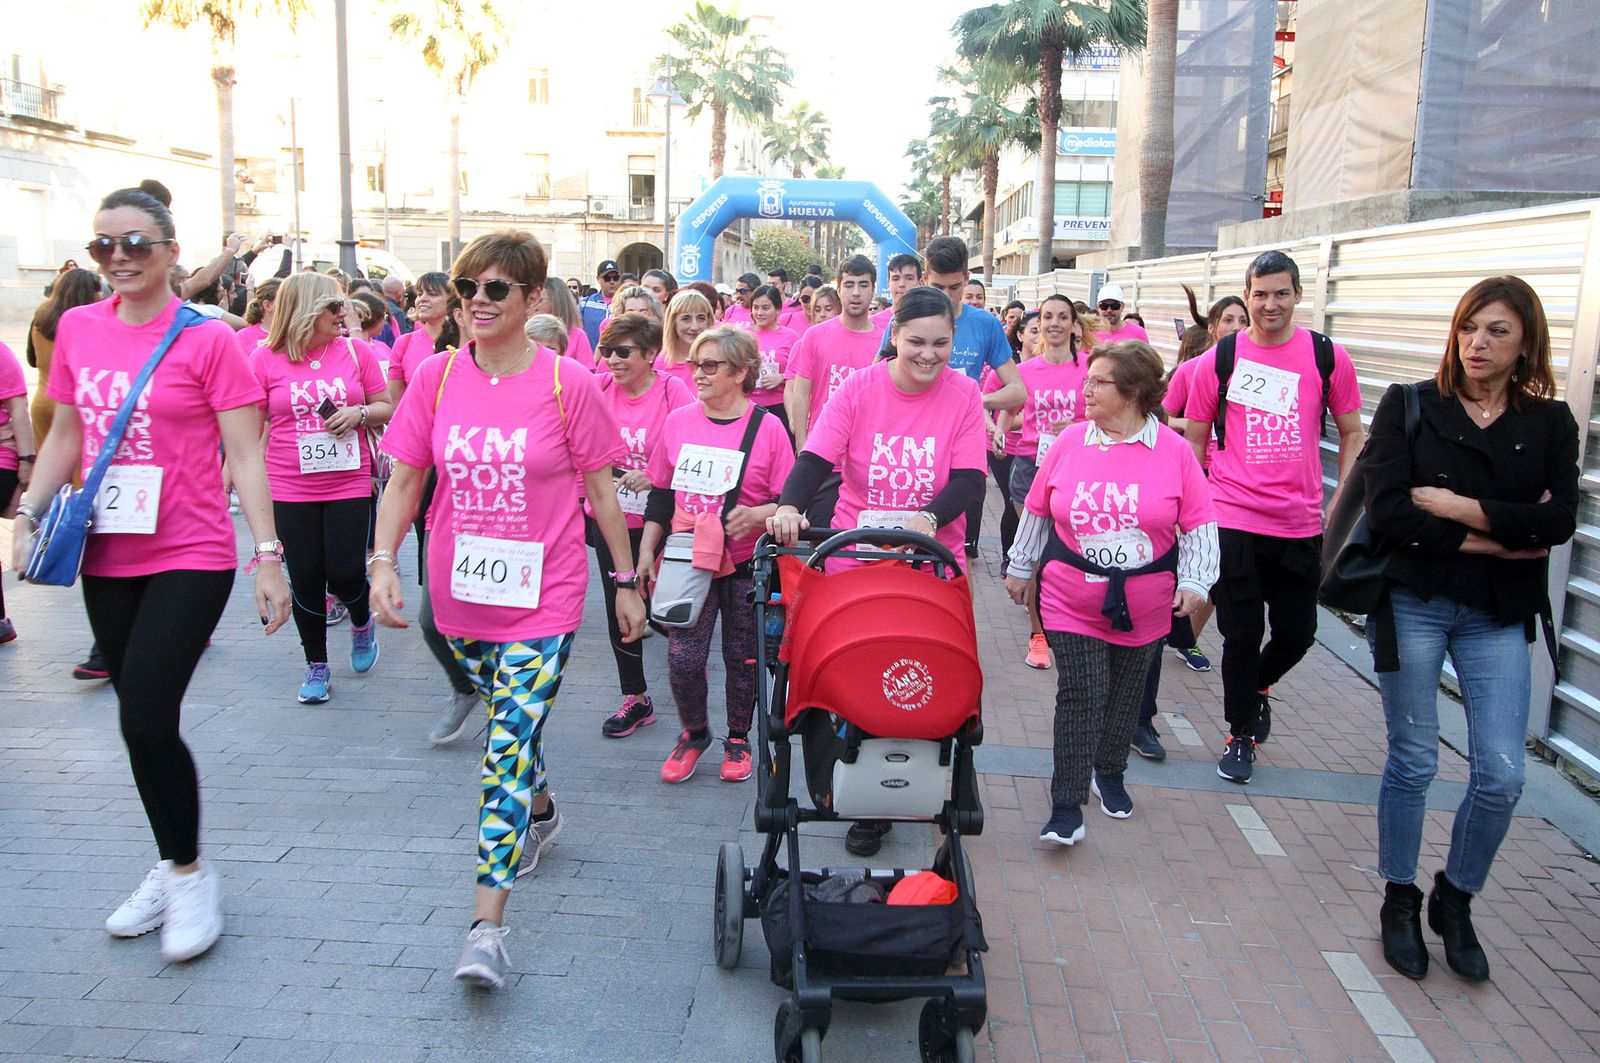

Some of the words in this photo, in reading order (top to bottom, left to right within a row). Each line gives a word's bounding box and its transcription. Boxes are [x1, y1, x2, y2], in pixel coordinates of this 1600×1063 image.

[691, 193, 728, 229] DEPORTES
[788, 207, 835, 217] HUELVA
[789, 199, 825, 207] Ayuntamiento
[863, 199, 898, 236] DEPORTES
[76, 367, 155, 410] KM
[290, 377, 347, 404] KM
[1240, 373, 1266, 394] 22
[1034, 389, 1076, 410] KM
[1246, 411, 1300, 432] POR
[444, 424, 528, 463] KM
[871, 432, 936, 468] KM
[1246, 430, 1302, 447] ELLAS
[301, 443, 338, 460] 354
[445, 462, 527, 491] POR
[678, 458, 714, 478] 441
[867, 464, 936, 491] POR
[452, 489, 527, 512] ELLAS
[867, 488, 935, 508] ELLAS
[1071, 481, 1139, 514] KM
[1085, 545, 1128, 566] 806
[456, 555, 508, 584] 440
